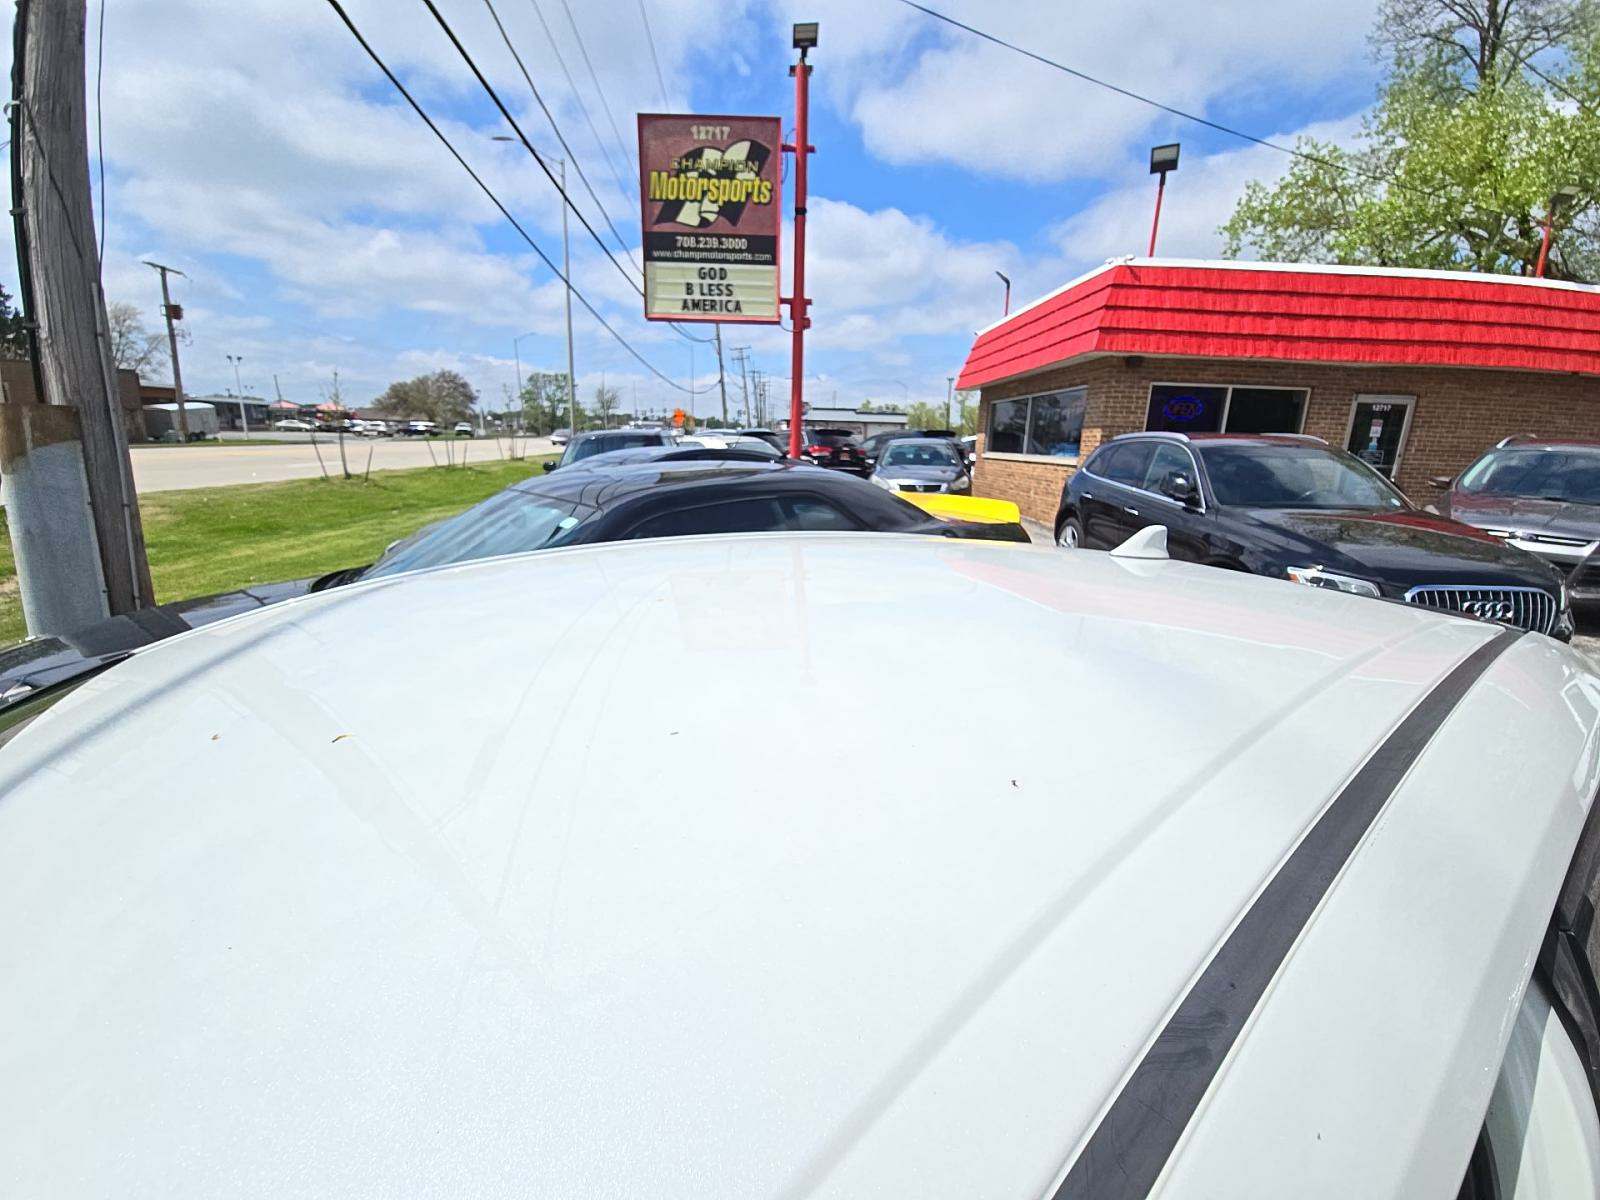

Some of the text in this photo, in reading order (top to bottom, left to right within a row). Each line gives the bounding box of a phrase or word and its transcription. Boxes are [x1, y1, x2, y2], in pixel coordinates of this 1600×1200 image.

[690, 125, 731, 140] 12717
[670, 157, 759, 172] CHAMPION
[649, 170, 773, 207] Motorsports
[675, 236, 748, 249] 708.239.3000
[652, 250, 772, 261] www.champmotorsports.com
[697, 267, 727, 280] GOD
[681, 298, 742, 313] AMERICA
